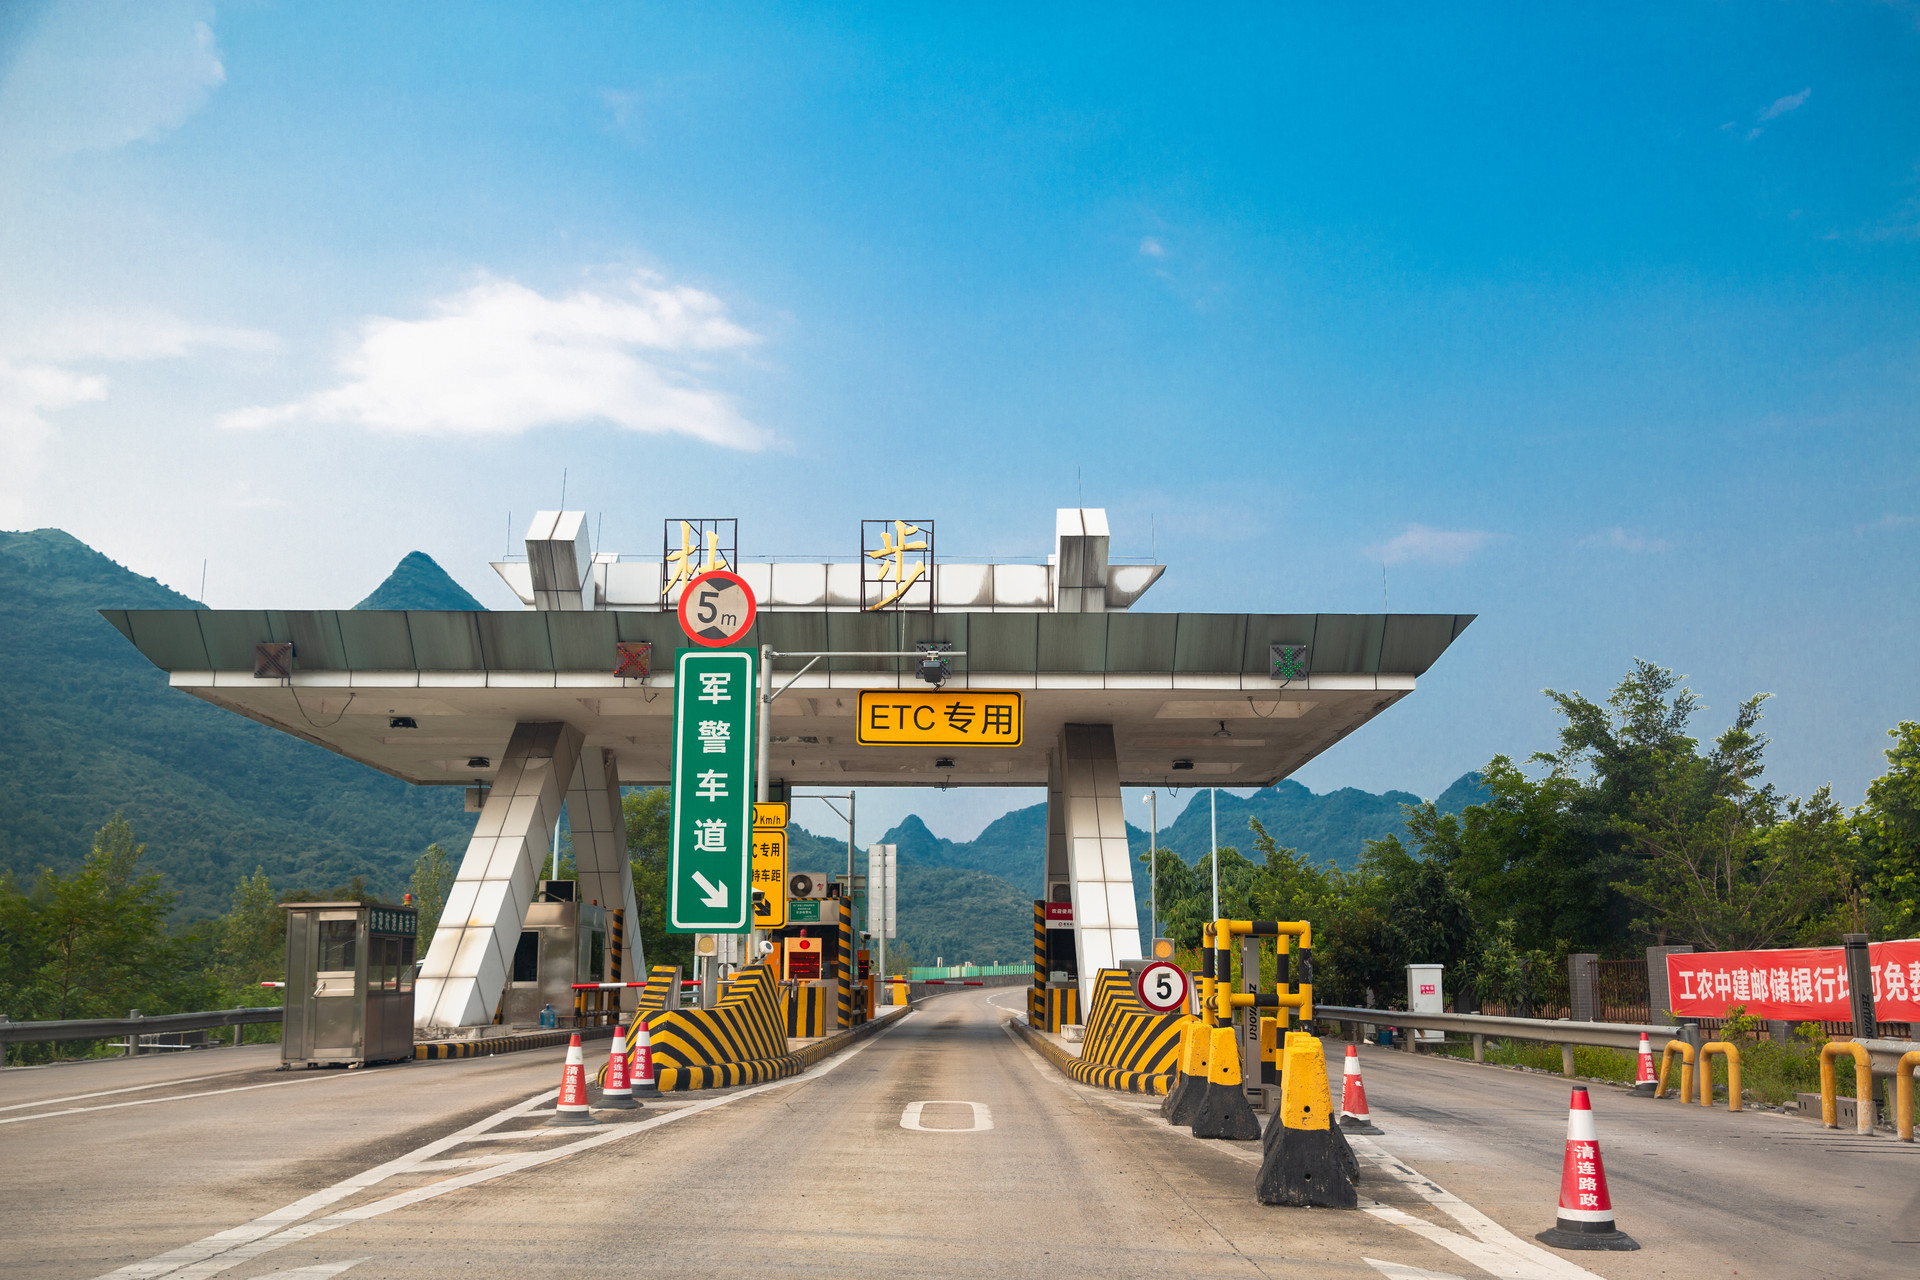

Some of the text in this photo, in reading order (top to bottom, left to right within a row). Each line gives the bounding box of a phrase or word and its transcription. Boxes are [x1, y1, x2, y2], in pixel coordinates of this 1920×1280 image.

[693, 672, 731, 853] 军警车道
[1156, 973, 1172, 999] 5
[613, 1055, 624, 1088] 清连路政
[635, 1048, 646, 1078] 清连路政
[563, 1066, 579, 1103] 清连高速
[1576, 1142, 1599, 1207] 清连路政
